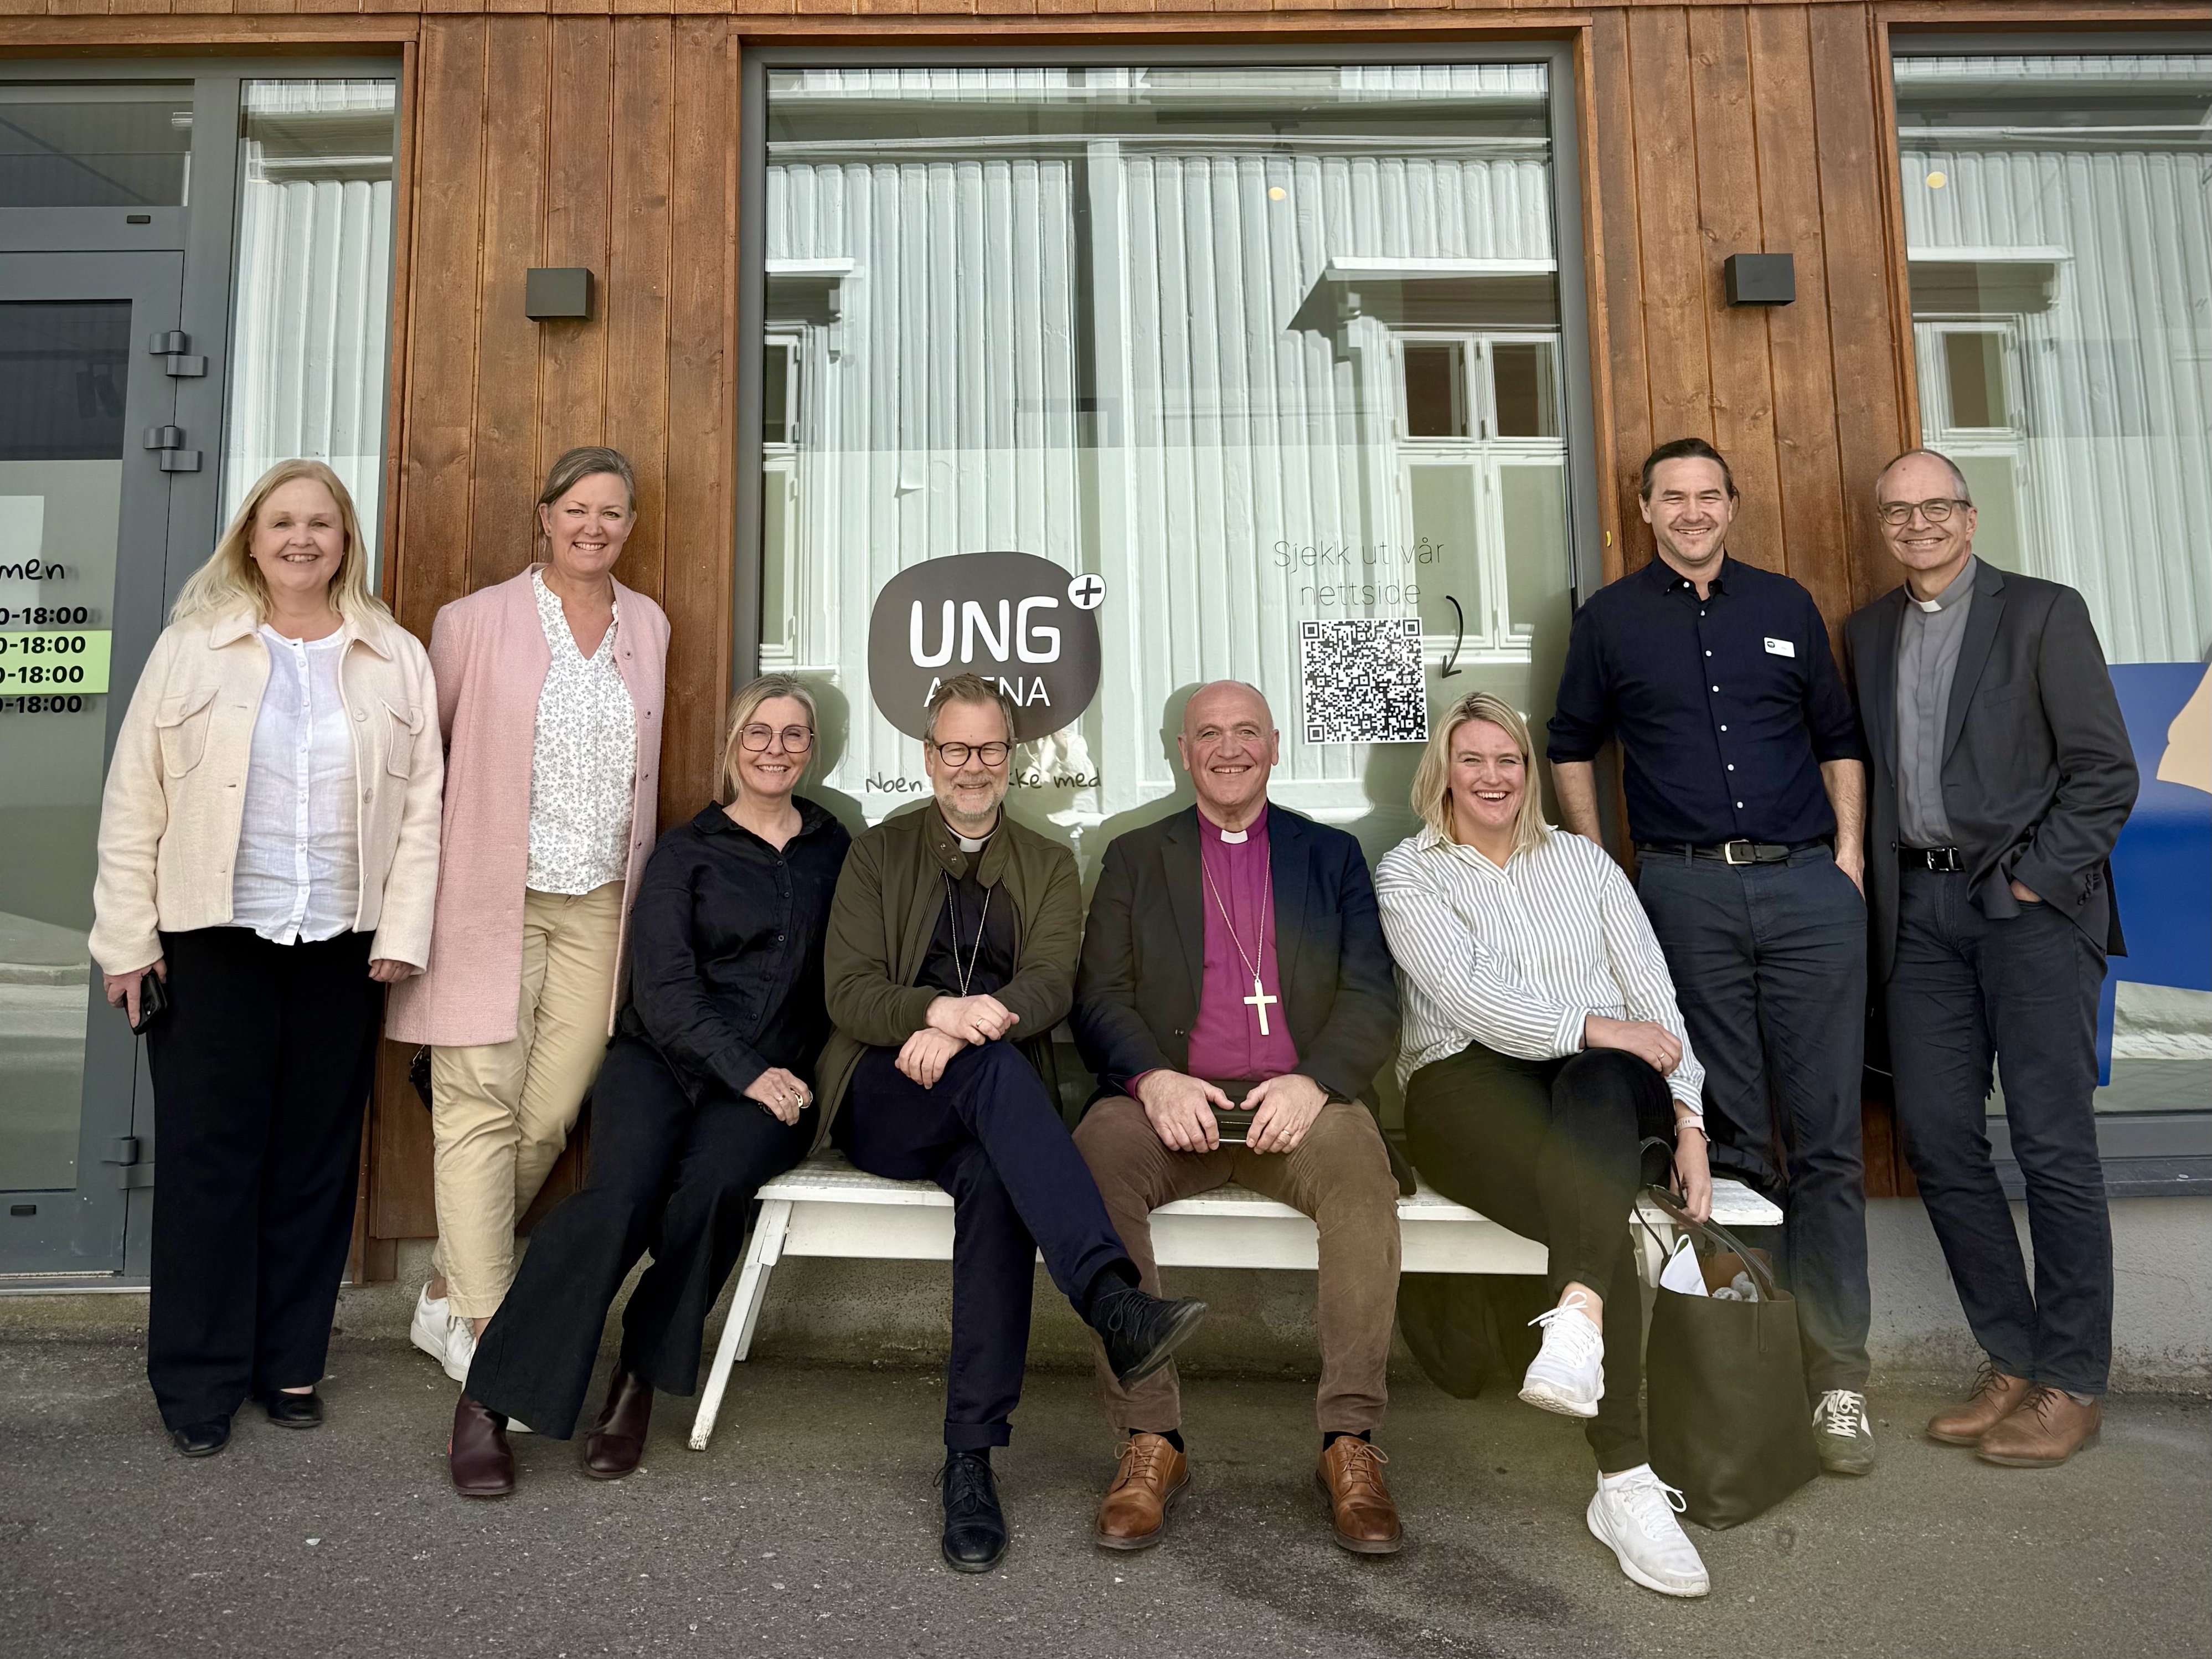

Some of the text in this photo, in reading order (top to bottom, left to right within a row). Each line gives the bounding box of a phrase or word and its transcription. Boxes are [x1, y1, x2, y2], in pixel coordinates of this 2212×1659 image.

[1274, 537, 1445, 574] Sjekk ut vår
[1301, 579, 1421, 606] nettside
[910, 596, 1061, 668] UNG
[0, 695, 82, 713] -18:00
[924, 676, 1051, 708] ANA
[865, 771, 922, 793] Noen
[1053, 767, 1102, 789] med
